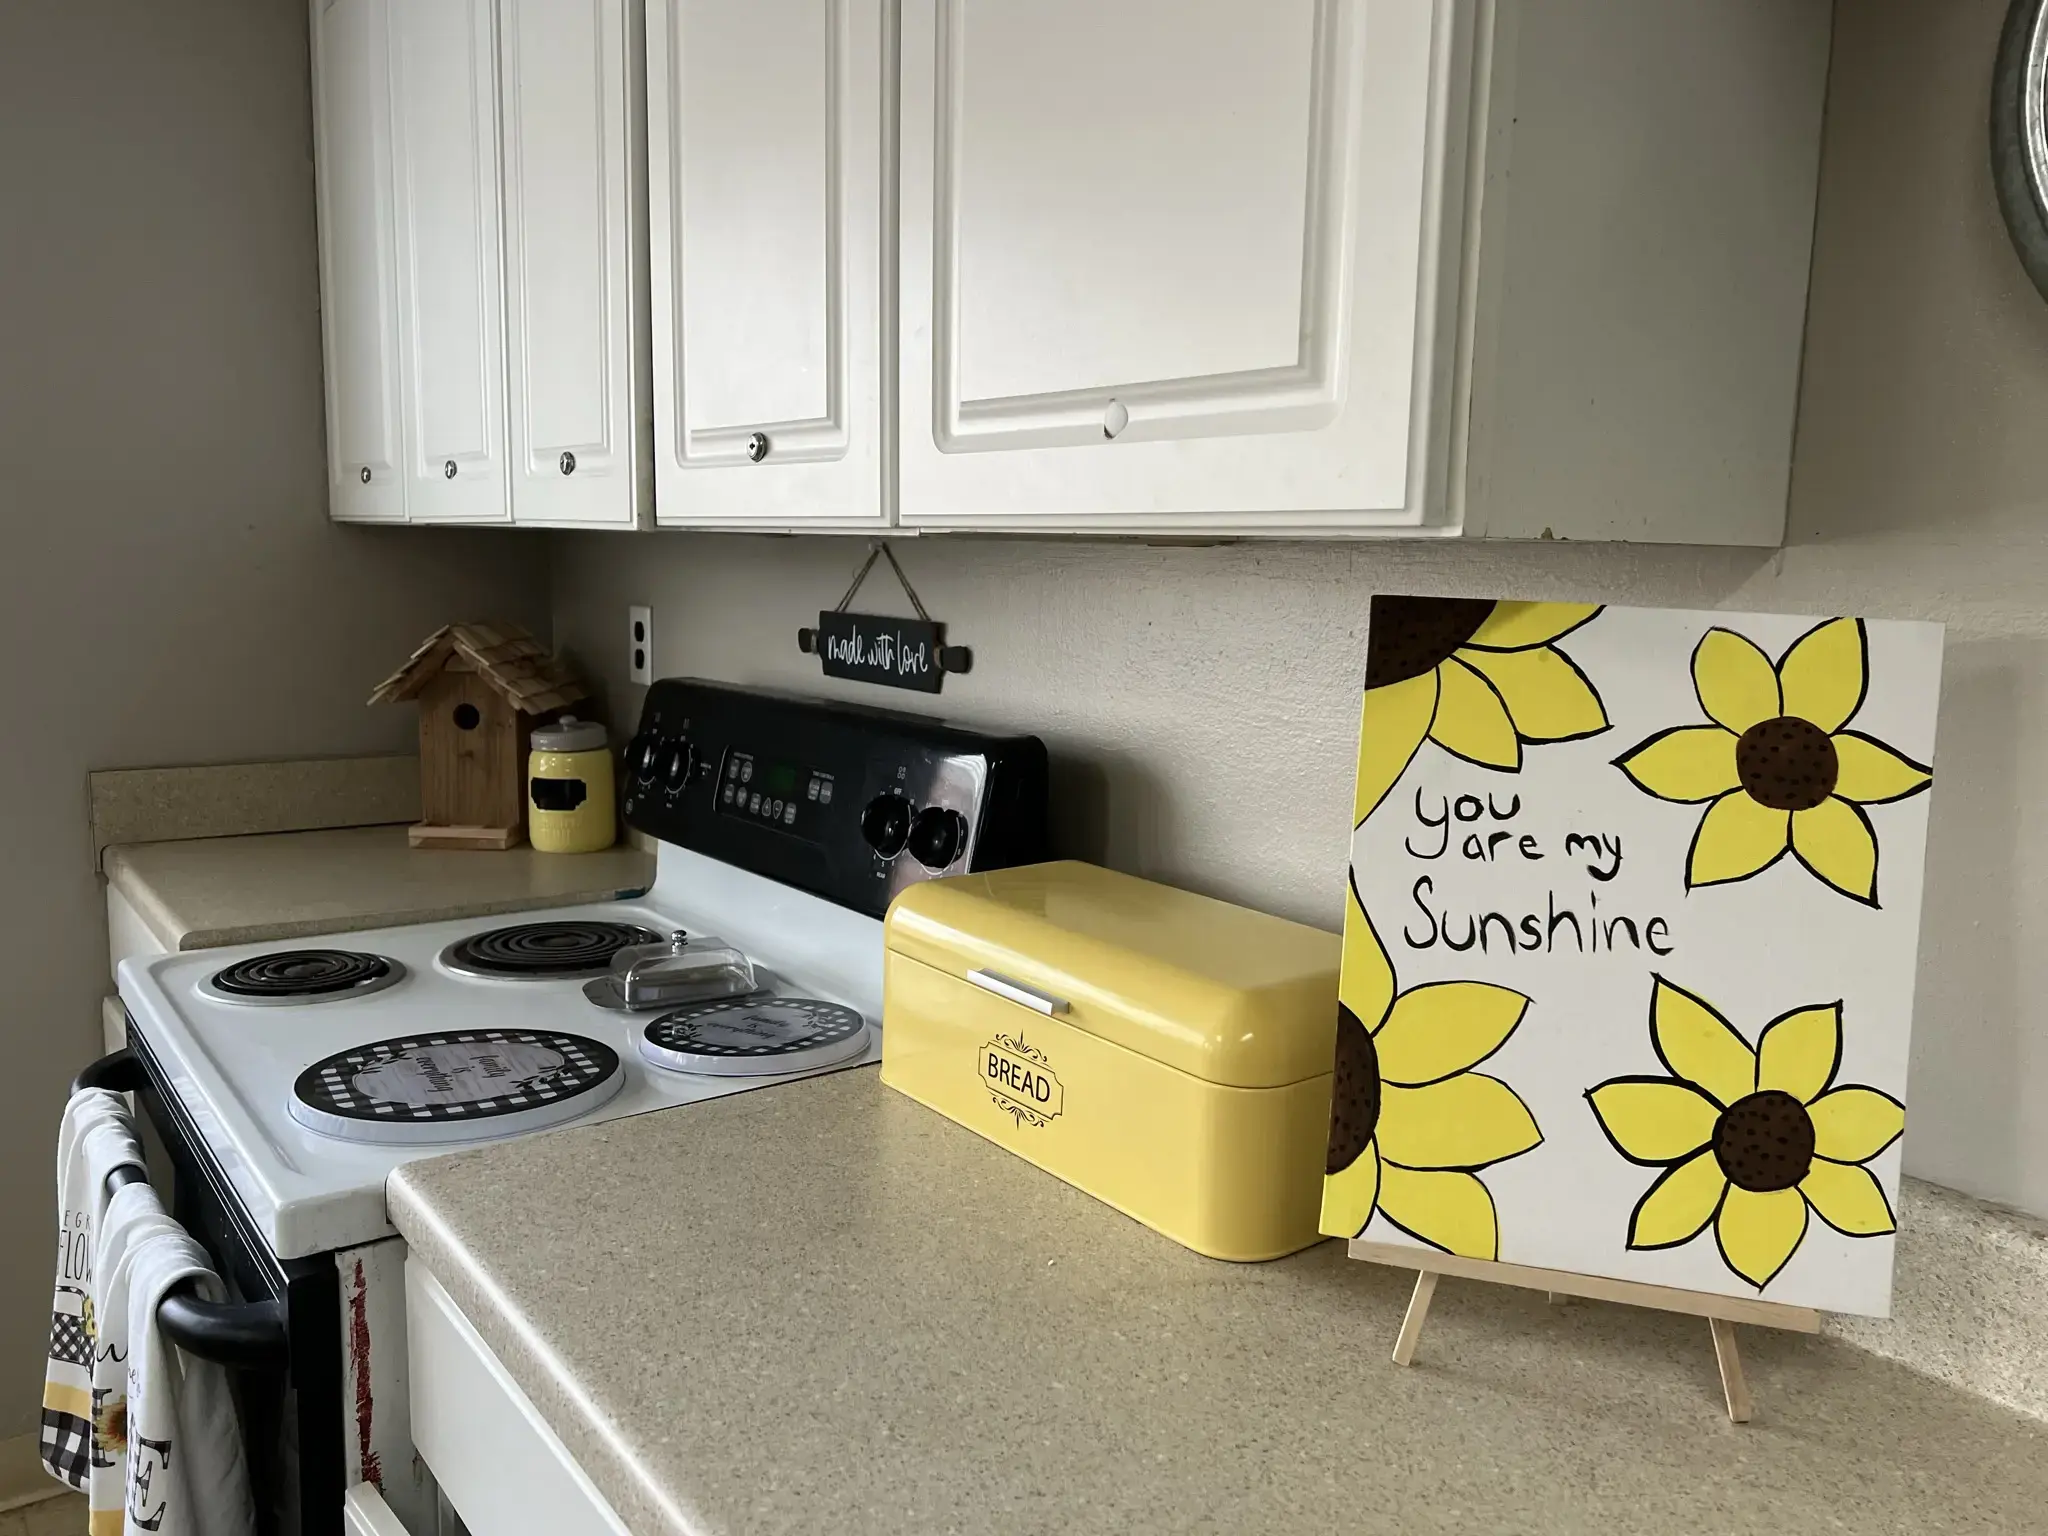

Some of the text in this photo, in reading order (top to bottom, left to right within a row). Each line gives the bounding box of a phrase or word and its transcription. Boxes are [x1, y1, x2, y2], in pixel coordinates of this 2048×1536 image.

[828, 624, 928, 676] made with love
[1405, 785, 1521, 860] you
[1462, 831, 1623, 881] are my
[1404, 874, 1674, 956] Sunshine
[987, 1052, 1051, 1103] BREAD
